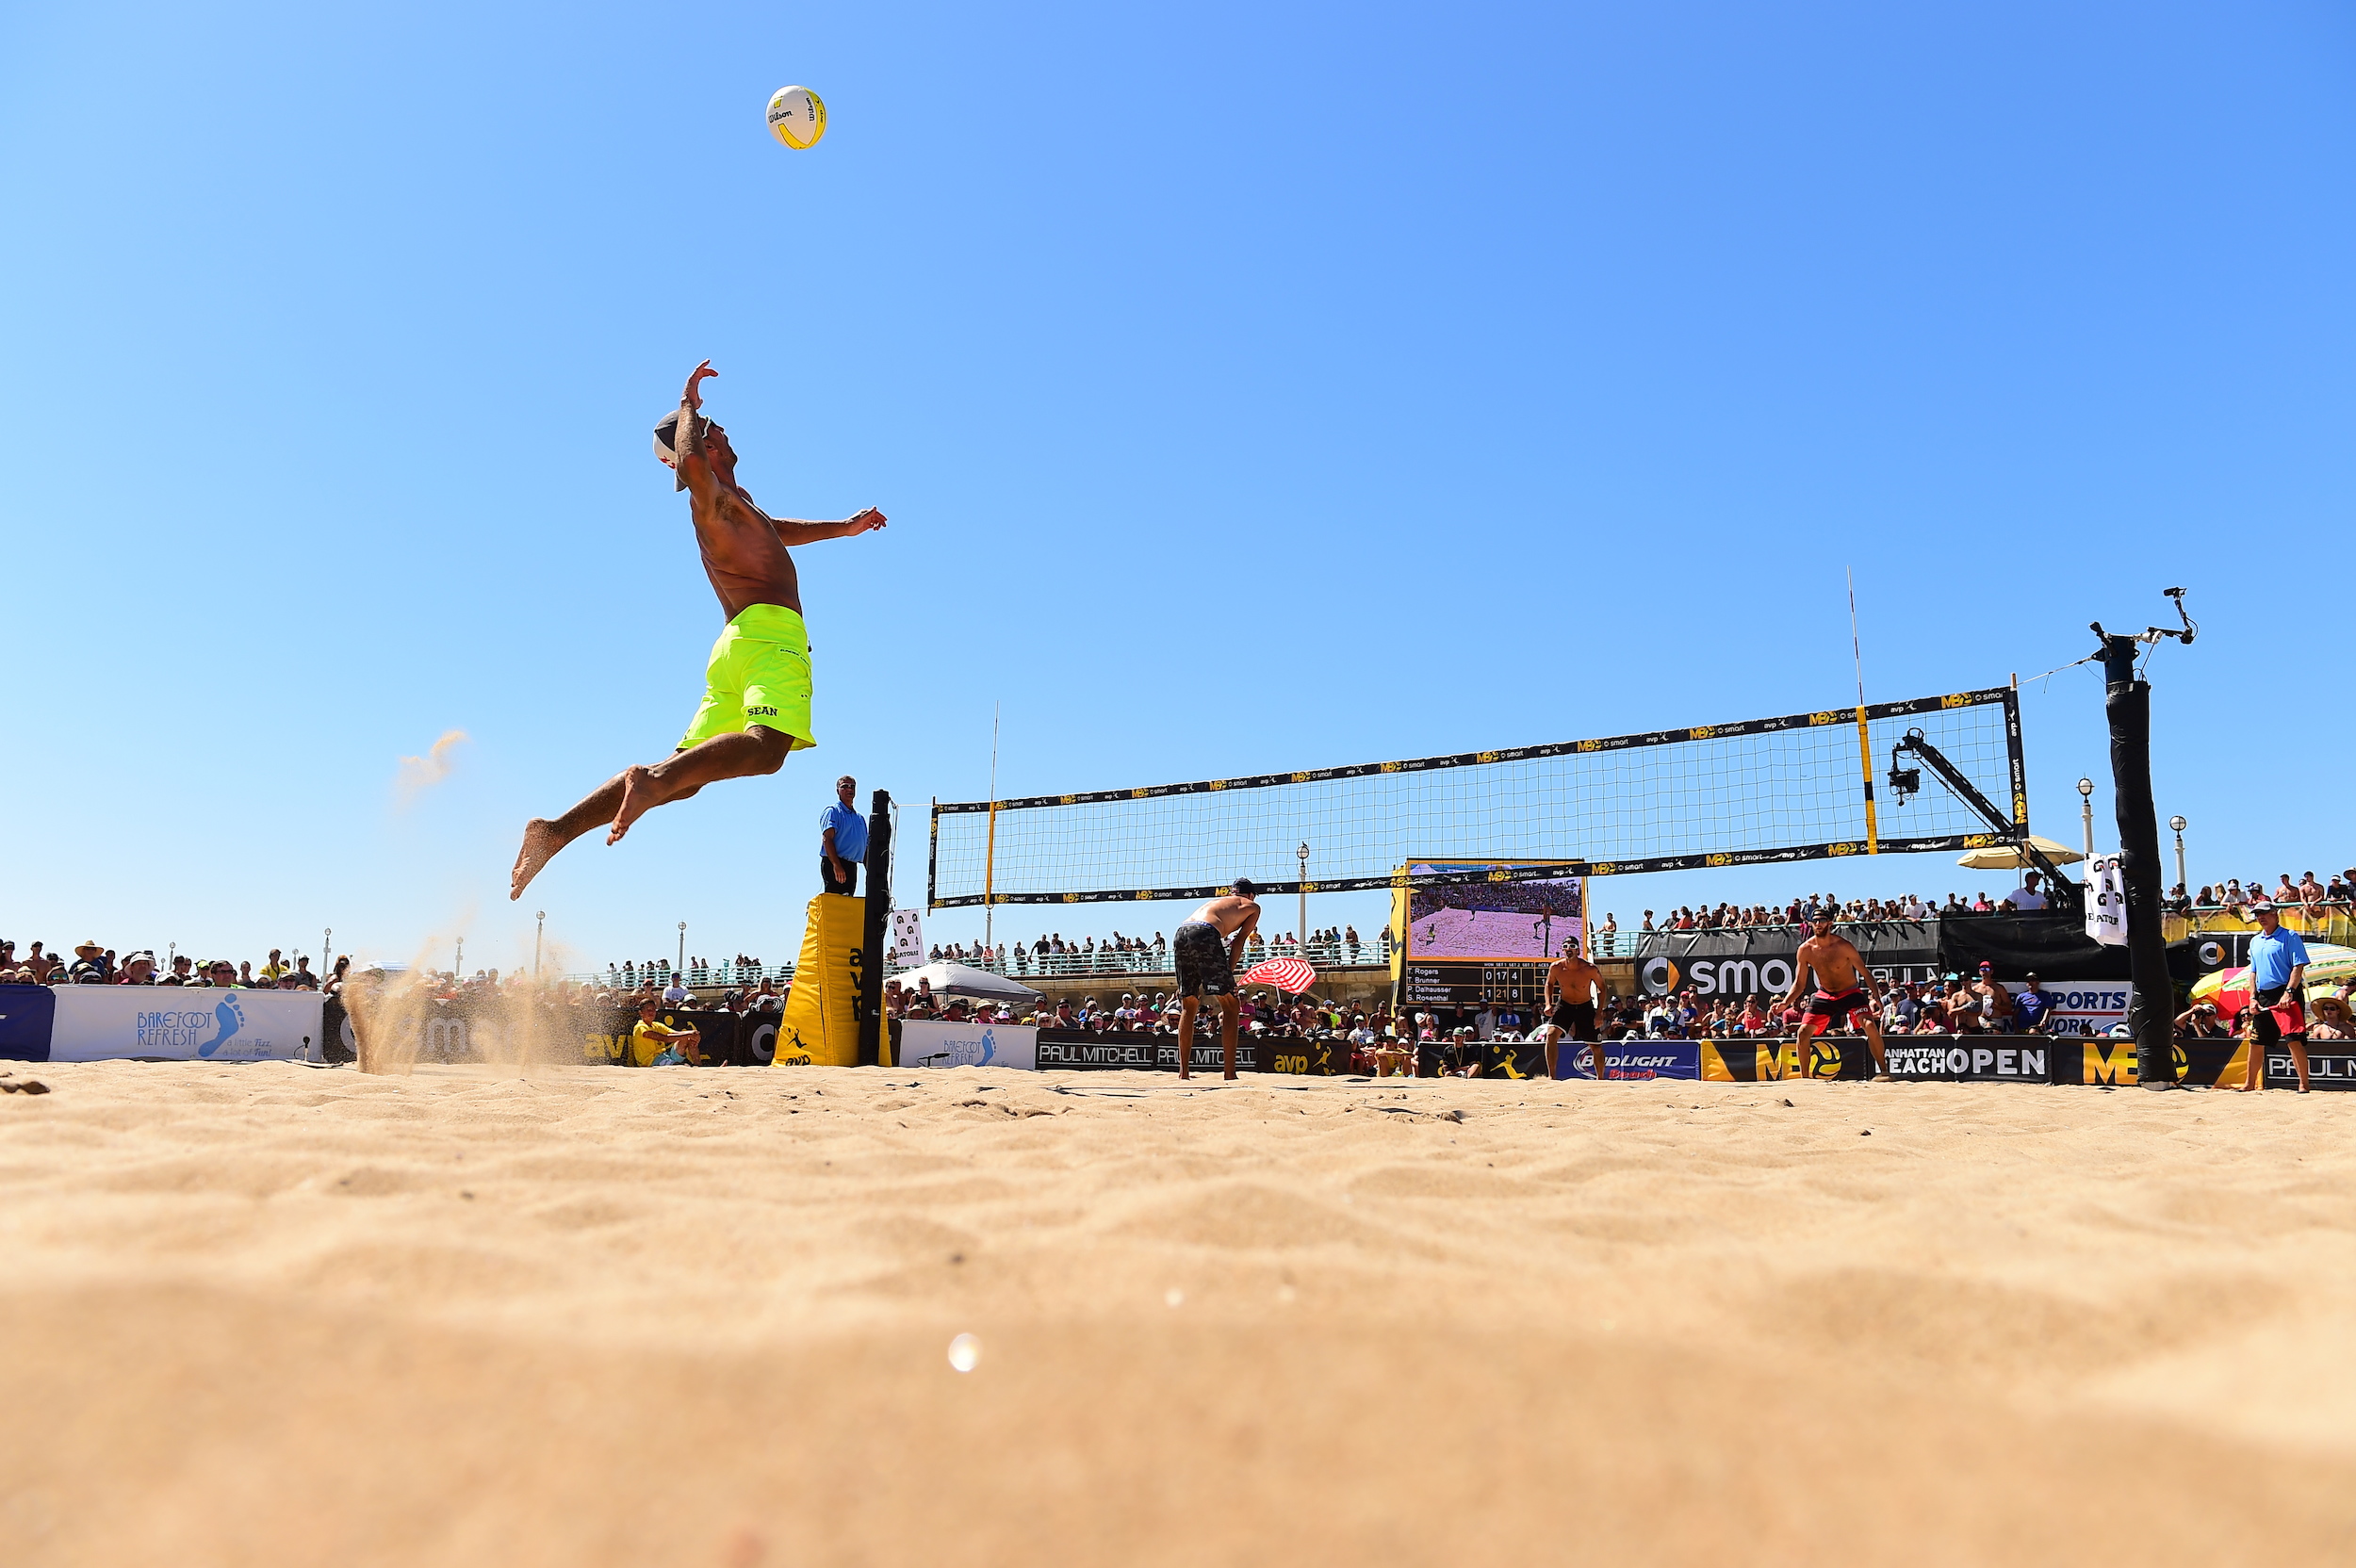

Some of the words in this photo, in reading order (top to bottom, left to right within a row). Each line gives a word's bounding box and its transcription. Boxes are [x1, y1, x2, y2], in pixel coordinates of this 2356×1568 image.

[768, 110, 793, 123] Wilson
[747, 707, 777, 717] SEAN
[1408, 760, 1426, 769] smart
[1506, 749, 1524, 758] smart
[1610, 738, 1629, 746] smart
[1724, 725, 1745, 733] smart
[1890, 706, 1905, 714] avp
[2013, 759, 2021, 782] smart
[1624, 862, 1644, 871] smart
[1742, 853, 1763, 861] smart
[1485, 972, 1493, 981] 0
[1496, 971, 1507, 980] 17
[1512, 972, 1517, 980] 4
[1487, 989, 1492, 998] 1
[1497, 989, 1507, 998] 21
[1512, 989, 1518, 998] 8
[2051, 991, 2127, 1010] PORTS
[138, 1011, 213, 1029] BAREFOOT
[138, 1029, 197, 1046] REFRESH
[235, 1038, 253, 1047] little
[243, 1048, 253, 1056] of
[943, 1039, 981, 1054] BAREFOOT
[1039, 1045, 1081, 1061] PAUL
[1082, 1046, 1151, 1063] MITCHELL
[1885, 1048, 1945, 1058] ANHATTAN
[785, 1054, 810, 1066] avp
[1195, 1049, 1255, 1064] MITCELL
[1274, 1054, 1308, 1074] avp
[1580, 1054, 1621, 1067] BD
[1621, 1054, 1677, 1067] LIGHT
[1946, 1048, 2045, 1075] OPEN
[1608, 1069, 1657, 1079] Beach
